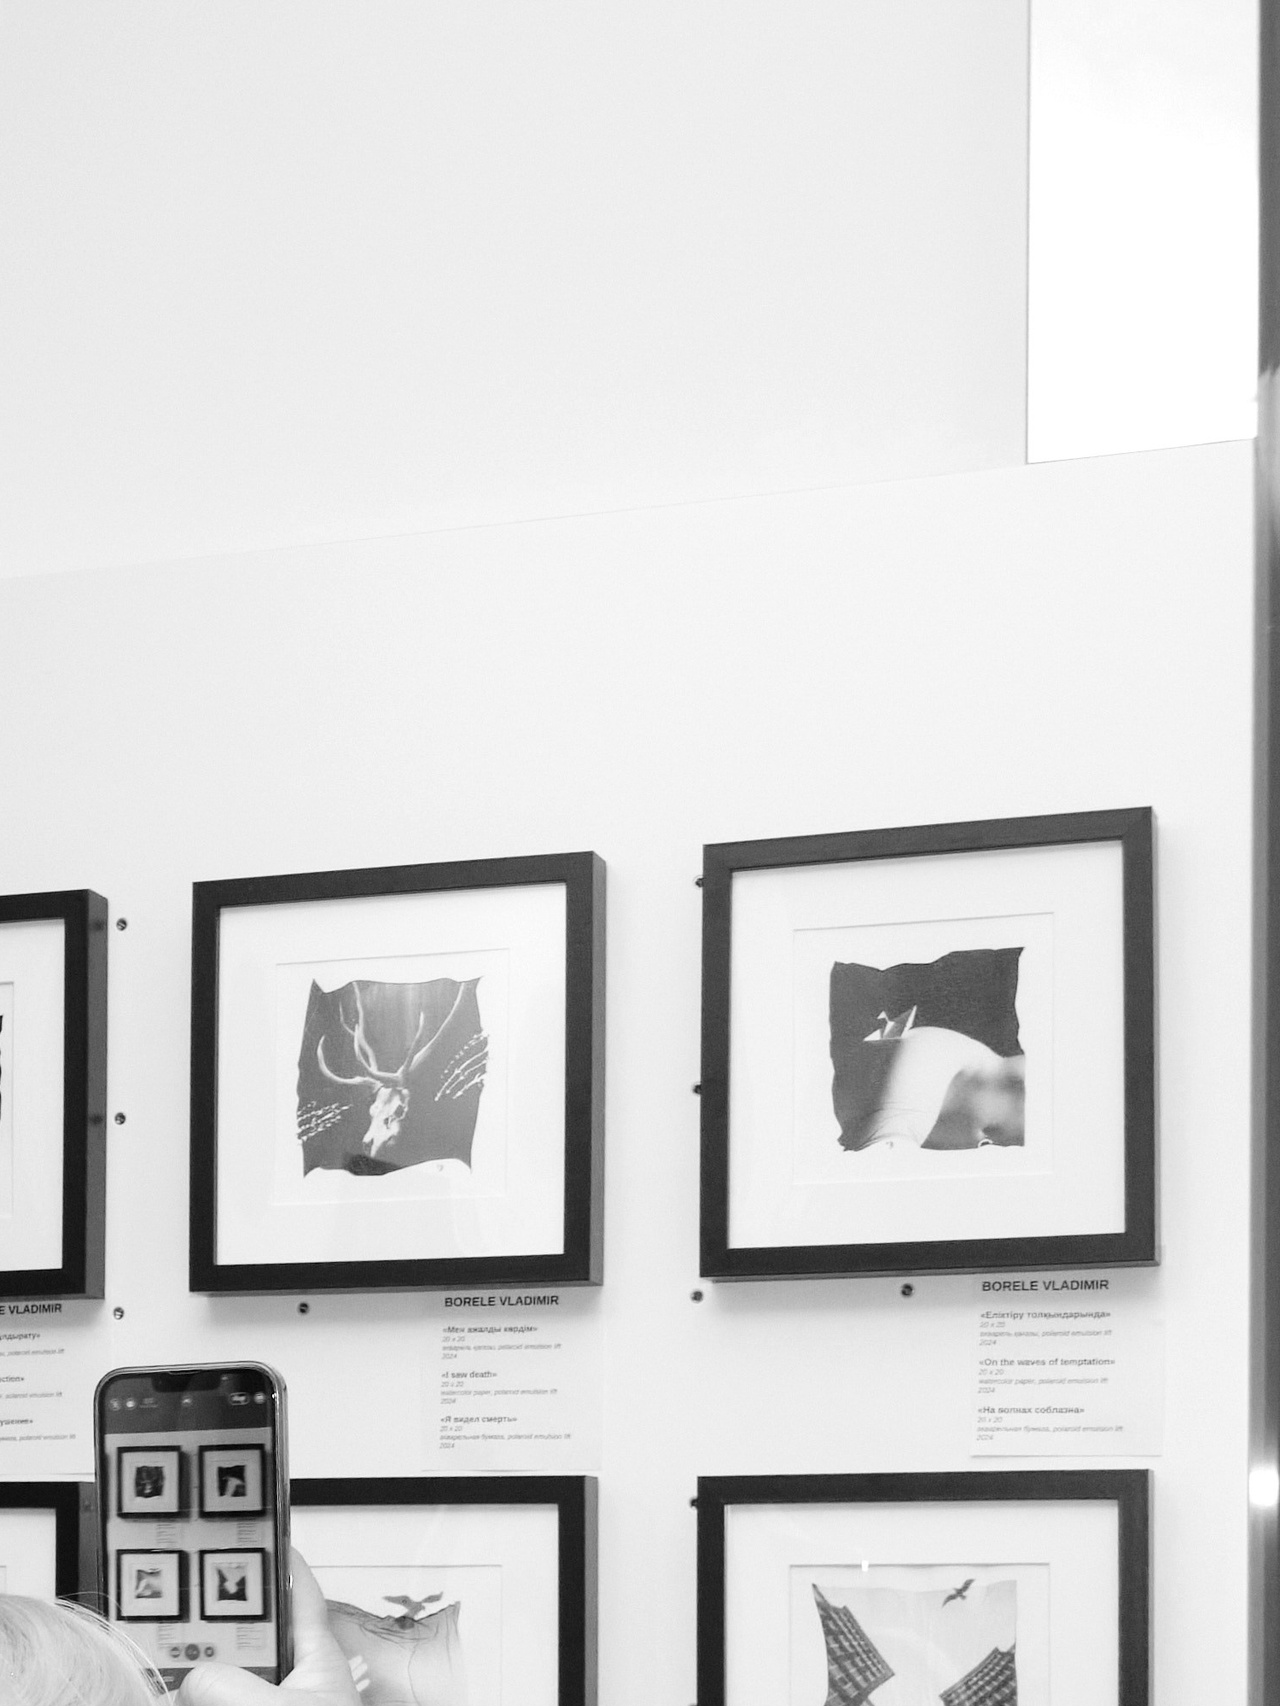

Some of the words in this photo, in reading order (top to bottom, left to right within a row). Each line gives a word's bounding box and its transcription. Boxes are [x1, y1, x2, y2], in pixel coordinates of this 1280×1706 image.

[982, 1280, 1038, 1291] BORELE
[1043, 1280, 1109, 1290] VLADIMIR
[444, 1296, 496, 1307] BORELE
[499, 1295, 559, 1306] VLADIMIR
[8, 1304, 62, 1314] VLADIMIR
[979, 1358, 998, 1366] «On
[1000, 1358, 1014, 1366] the
[1017, 1358, 1046, 1366] waves
[1049, 1358, 1058, 1366] of
[1060, 1358, 1115, 1366] temptation»
